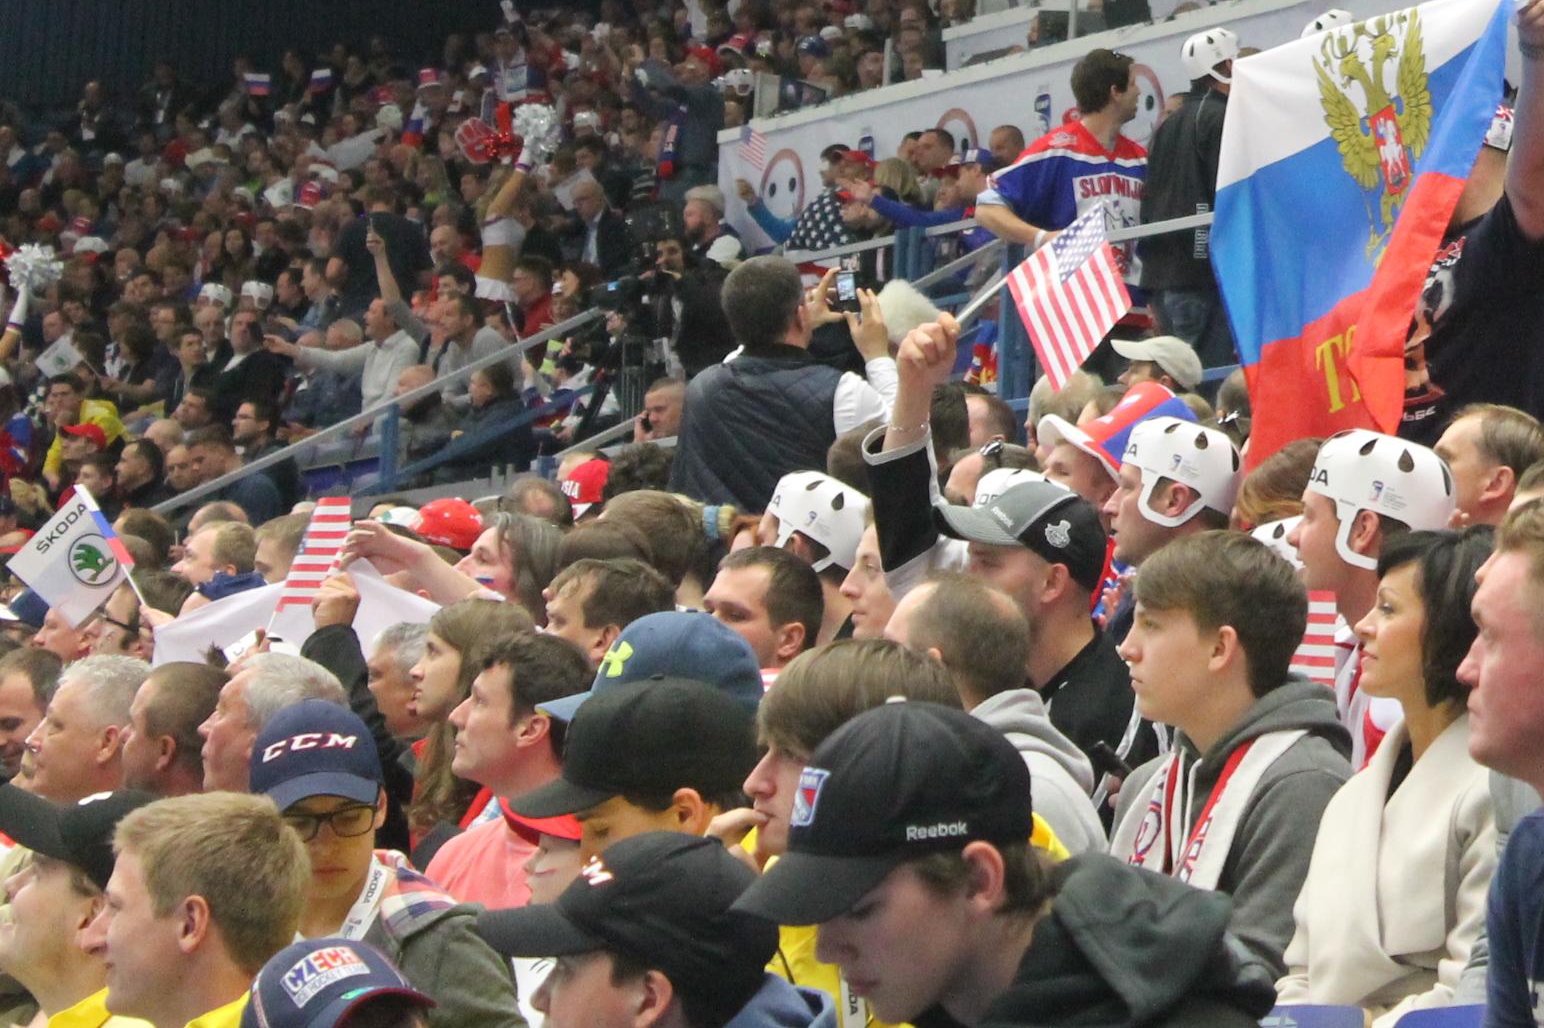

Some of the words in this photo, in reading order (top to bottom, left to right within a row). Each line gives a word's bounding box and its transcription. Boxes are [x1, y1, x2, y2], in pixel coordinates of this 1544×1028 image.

[262, 733, 358, 763] CCM
[906, 821, 968, 841] Reebok
[284, 947, 365, 992] CZECH
